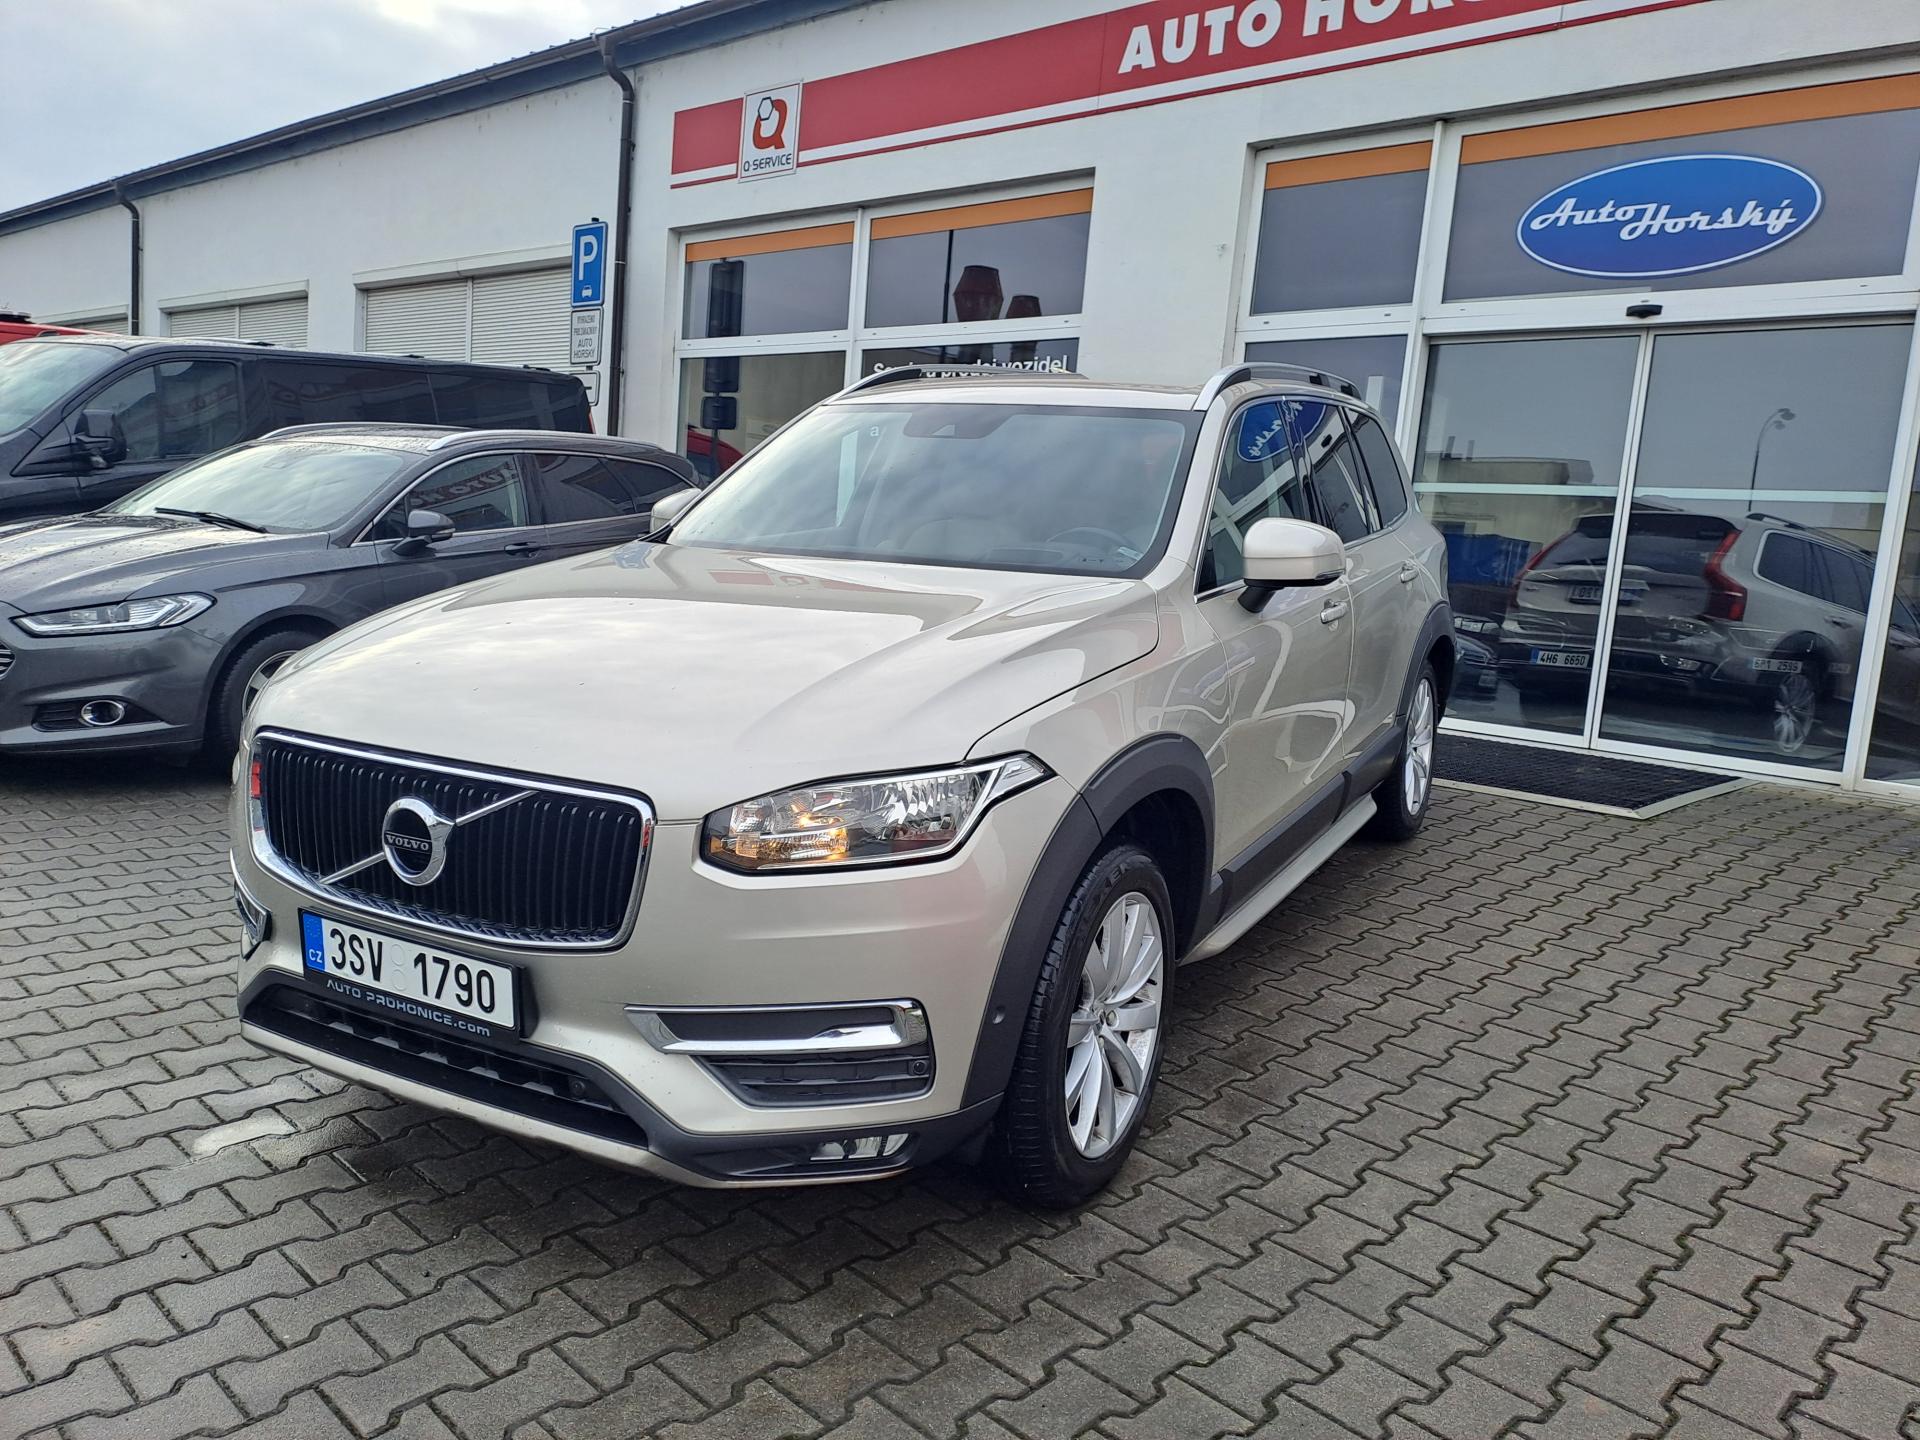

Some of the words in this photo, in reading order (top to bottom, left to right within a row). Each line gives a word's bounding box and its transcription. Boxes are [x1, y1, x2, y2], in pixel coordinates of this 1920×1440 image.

[1118, 0, 1283, 74] AUTO
[752, 153, 792, 171] SERVICE
[579, 235, 598, 281] P
[577, 338, 593, 348] AUTO
[1002, 354, 1068, 374] vozidel
[1540, 653, 1559, 664] 4H6
[1564, 655, 1586, 666] 6650
[385, 834, 429, 851] VOLVO
[308, 948, 323, 963] CZ
[330, 928, 383, 983] 3SV
[414, 952, 495, 1014] 1790
[326, 979, 361, 999] AUTO
